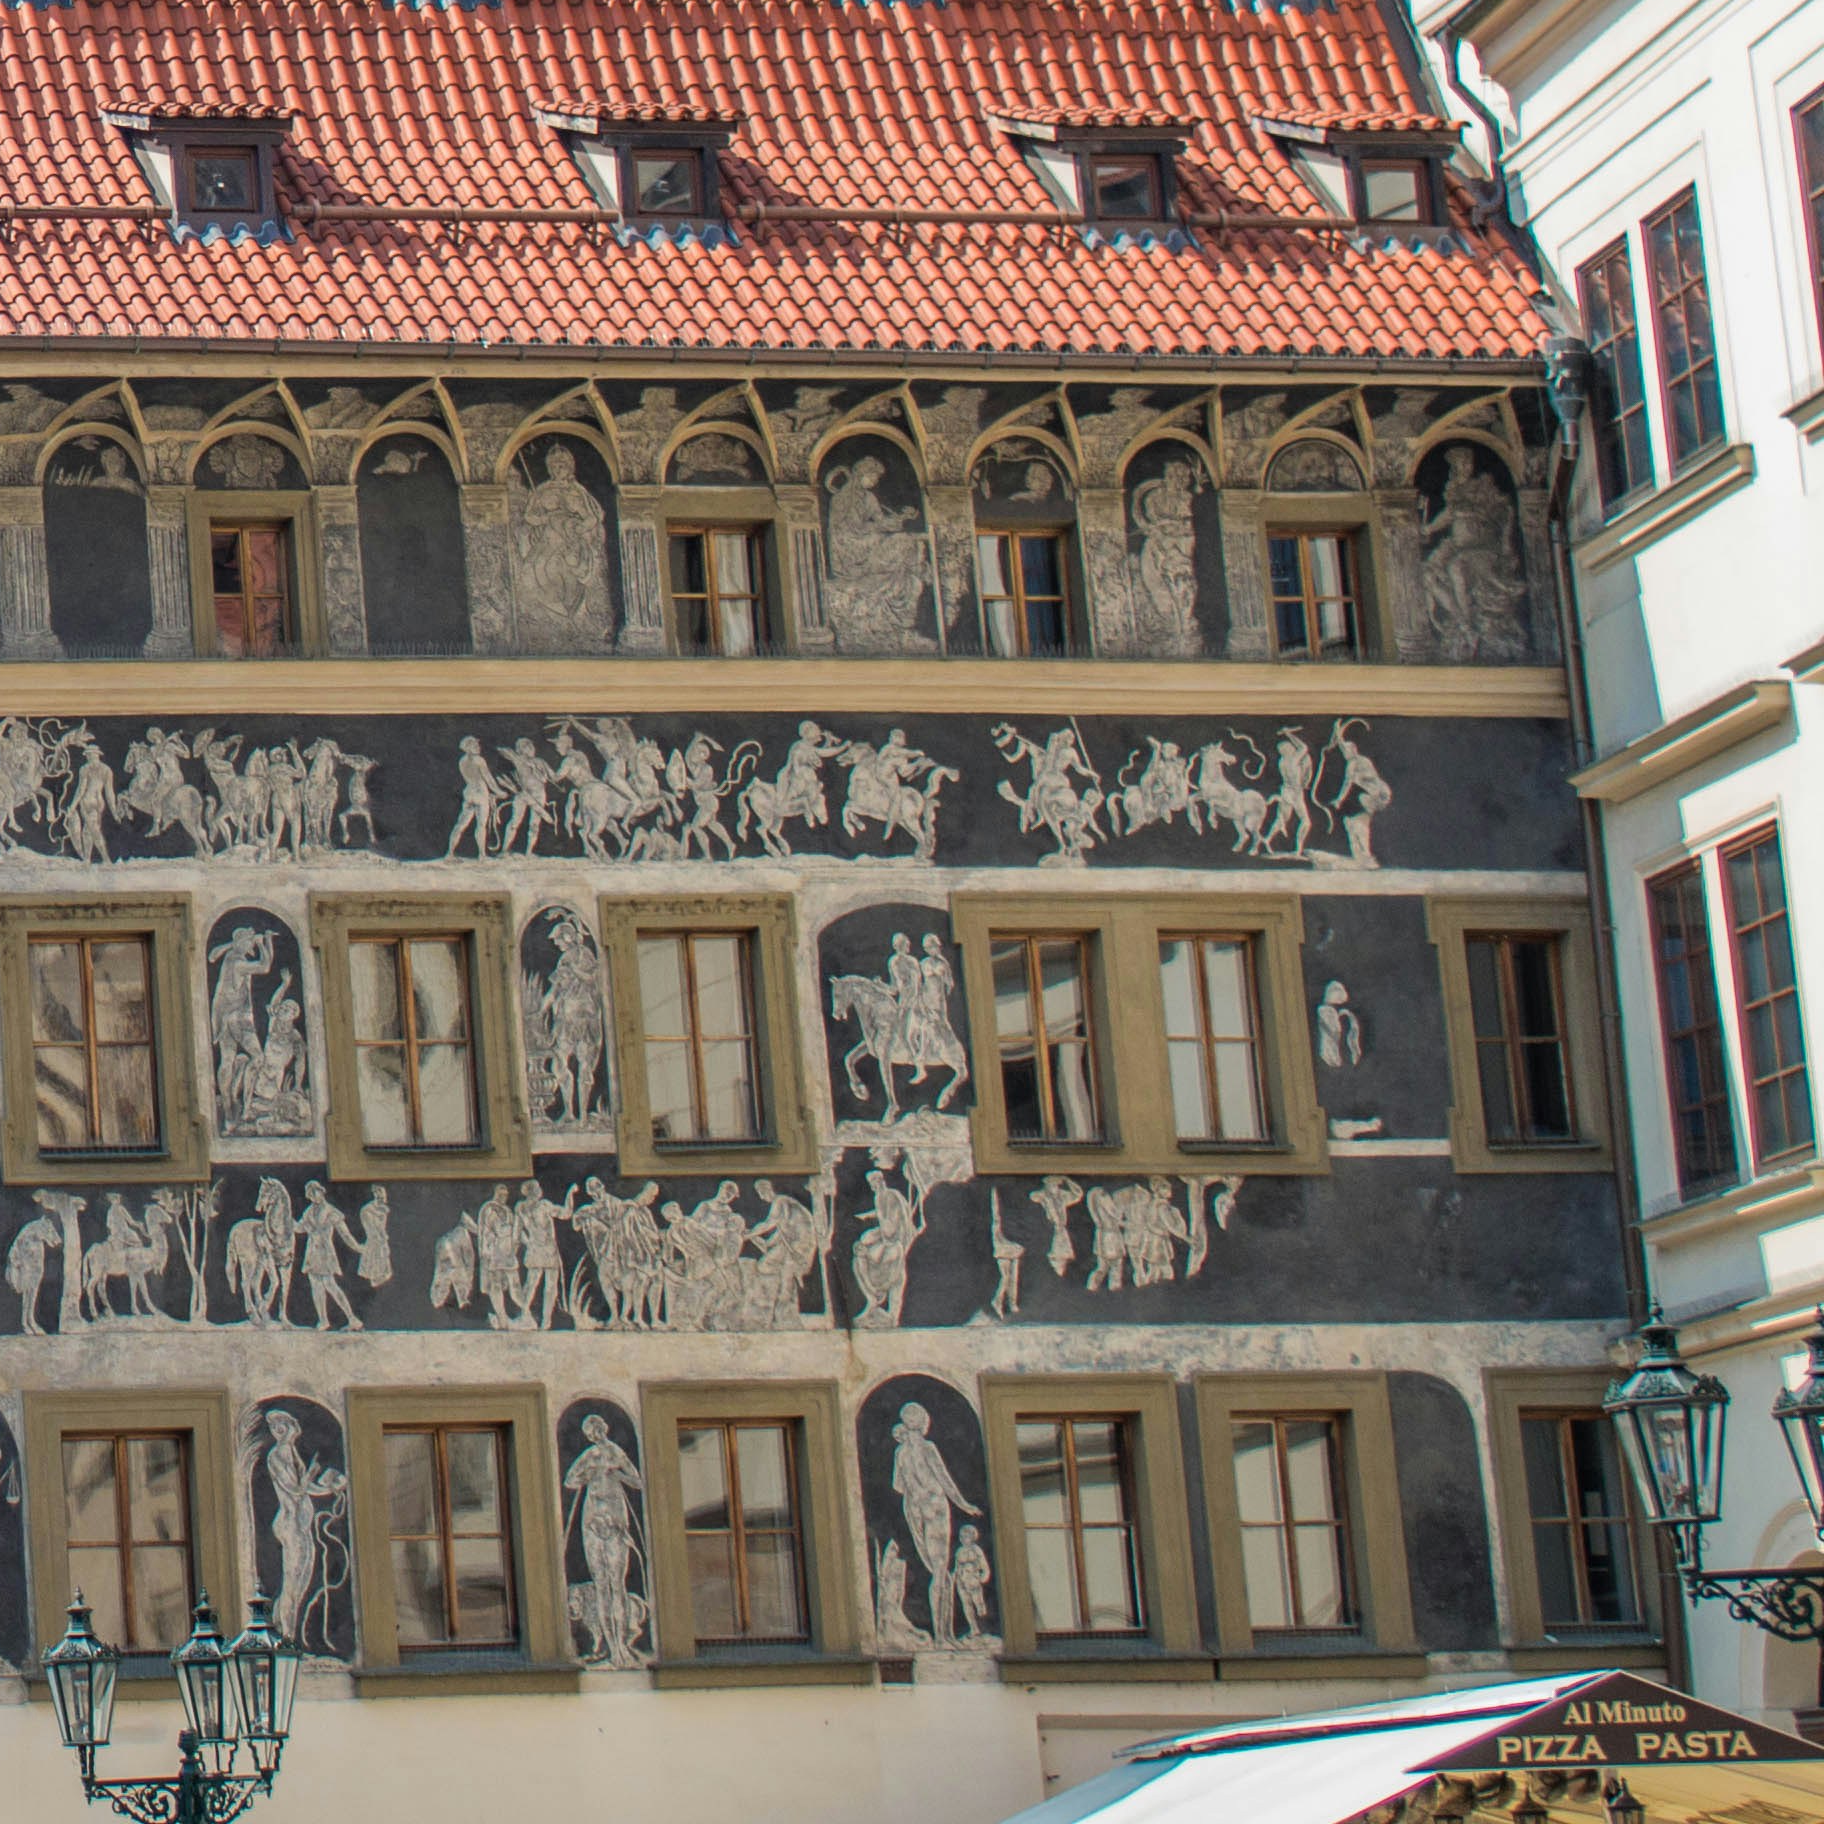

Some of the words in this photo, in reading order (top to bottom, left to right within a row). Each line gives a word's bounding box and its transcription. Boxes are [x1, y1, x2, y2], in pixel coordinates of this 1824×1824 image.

[1563, 1701, 1591, 1725] Al
[1596, 1700, 1687, 1724] Minuto
[1497, 1734, 1606, 1763] PIZZA
[1636, 1730, 1757, 1760] PASTA
